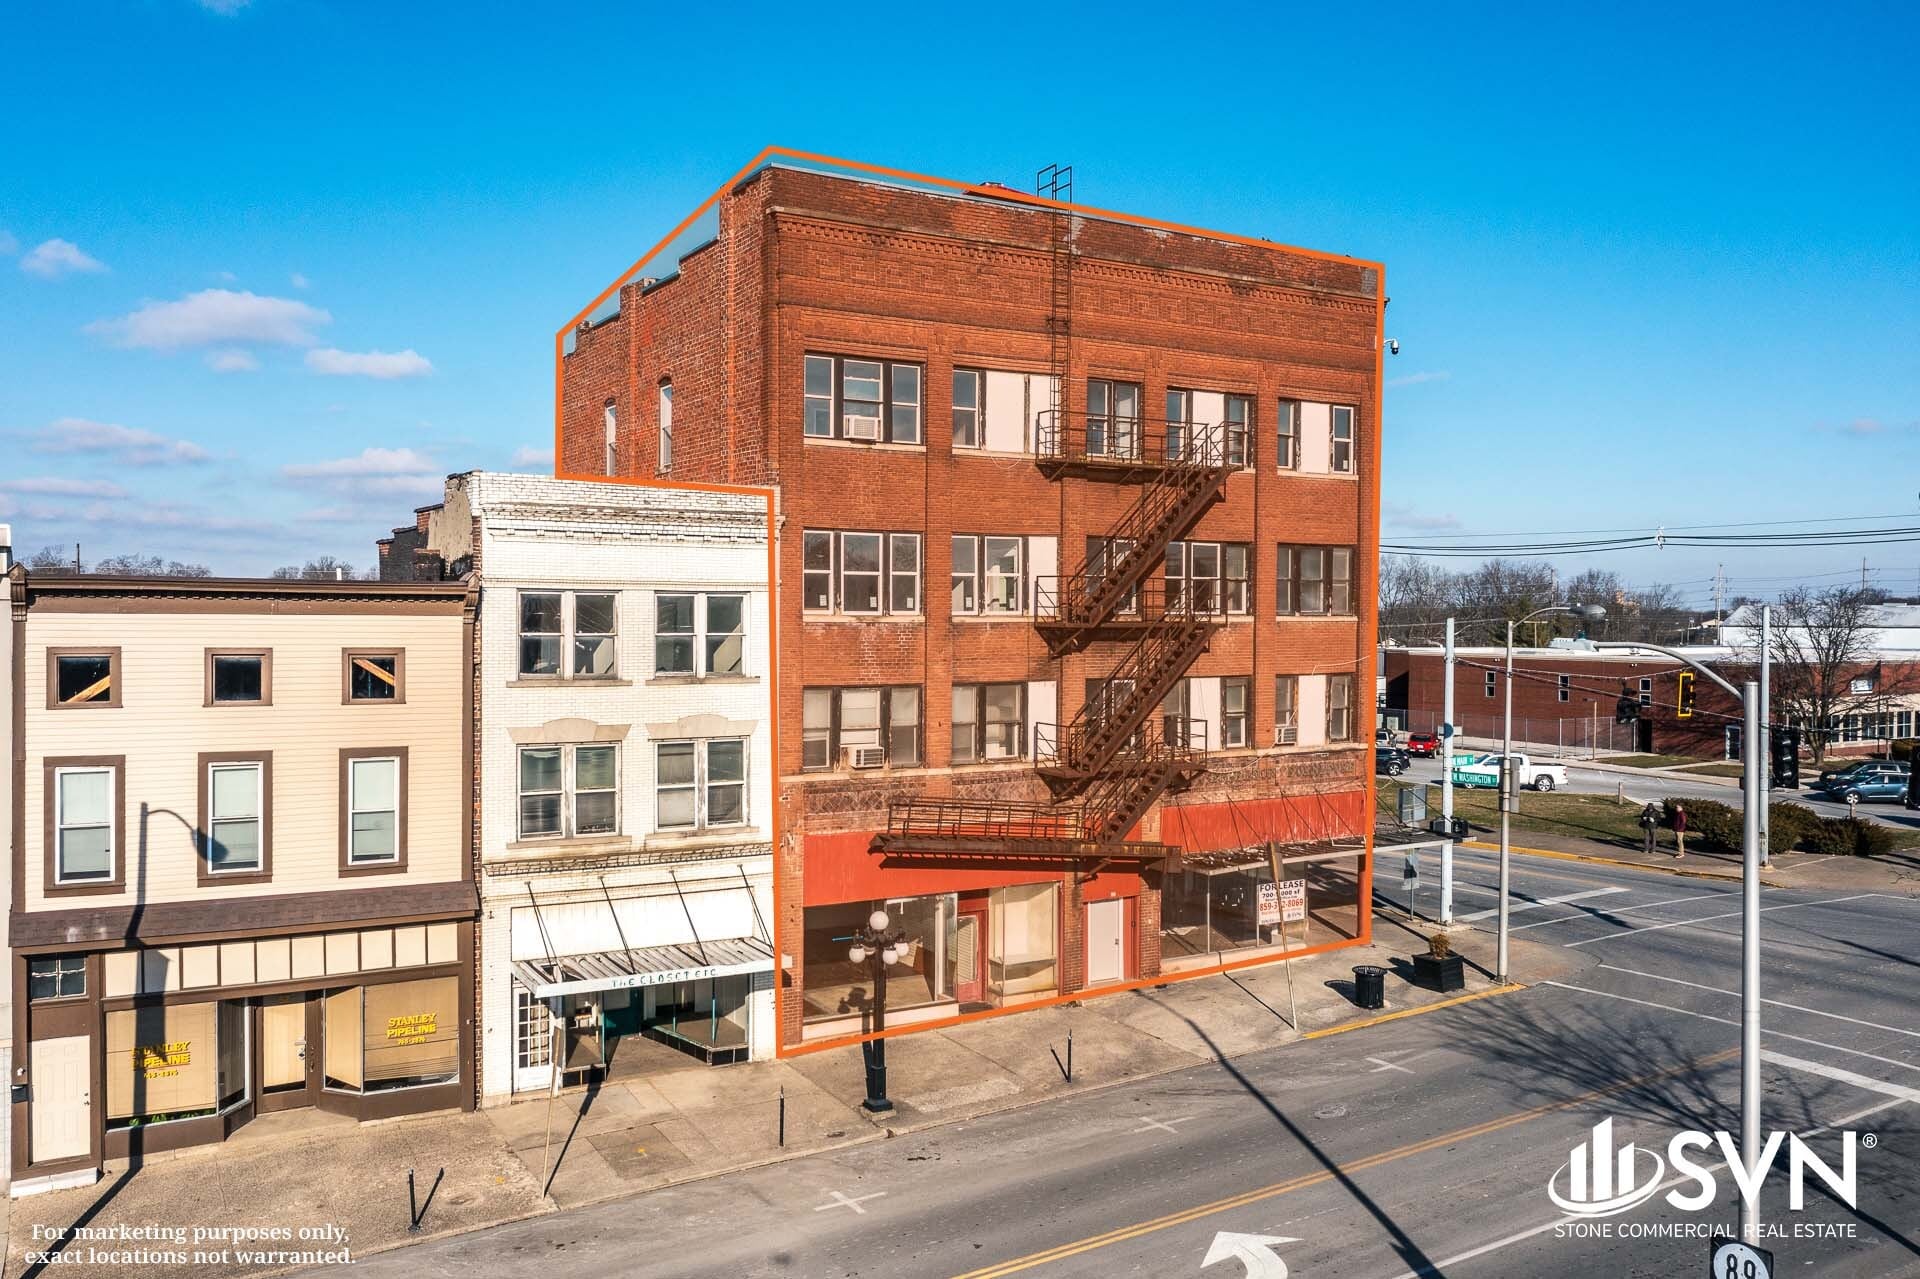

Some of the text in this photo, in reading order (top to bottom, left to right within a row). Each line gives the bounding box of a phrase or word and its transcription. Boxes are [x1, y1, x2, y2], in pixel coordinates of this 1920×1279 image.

[1459, 772, 1492, 785] WASHINGTON
[1260, 880, 1304, 892] FOR LEASE
[1260, 899, 1304, 911] 859-32-8069
[613, 978, 635, 988] THE
[388, 1012, 437, 1028] STANLEY
[387, 1023, 436, 1039] PIPELINE
